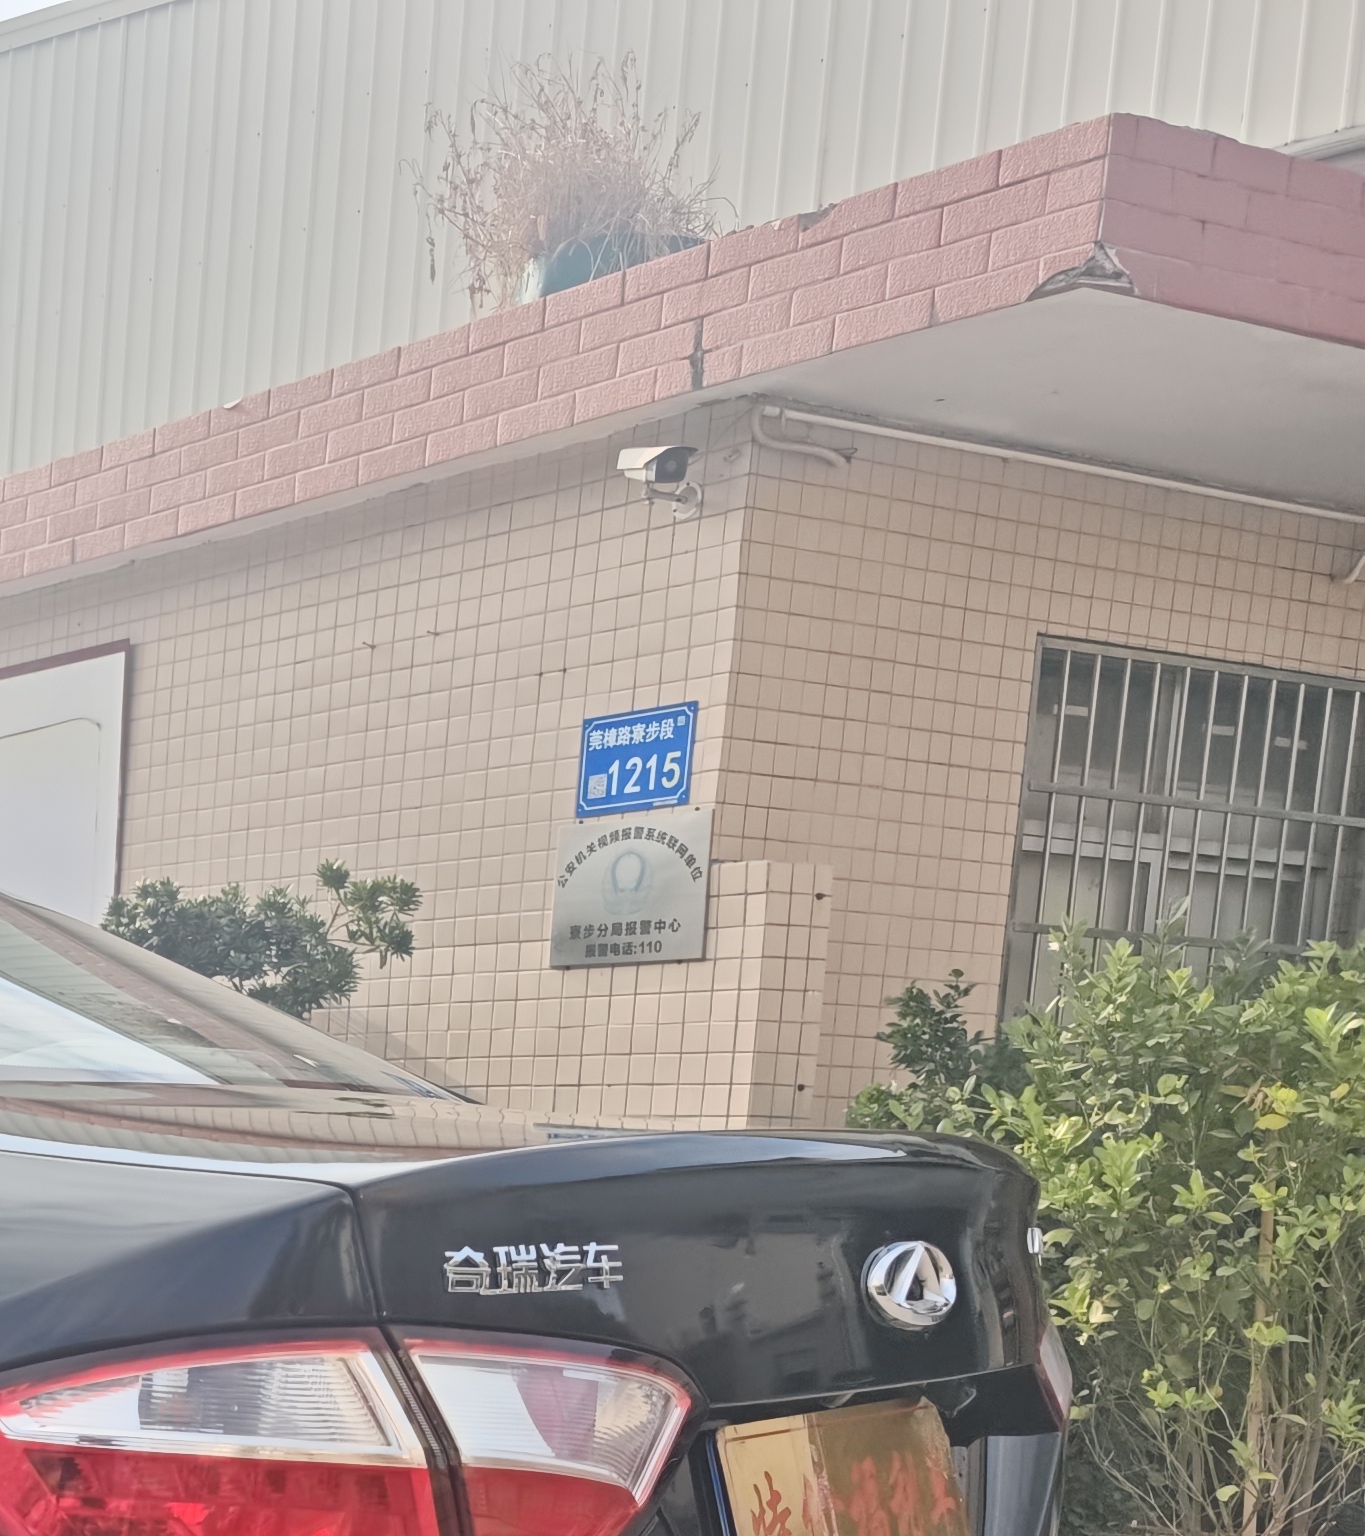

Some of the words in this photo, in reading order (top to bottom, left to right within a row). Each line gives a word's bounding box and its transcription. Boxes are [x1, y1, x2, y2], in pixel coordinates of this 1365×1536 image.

[588, 718, 675, 751] 莞樟路寮步段
[608, 750, 682, 796] 1215
[557, 826, 703, 888] 公安机关视频报警系统联网单位
[569, 918, 681, 940] 寮步分局报警中心
[443, 1241, 624, 1296] 奇瑞汽车
